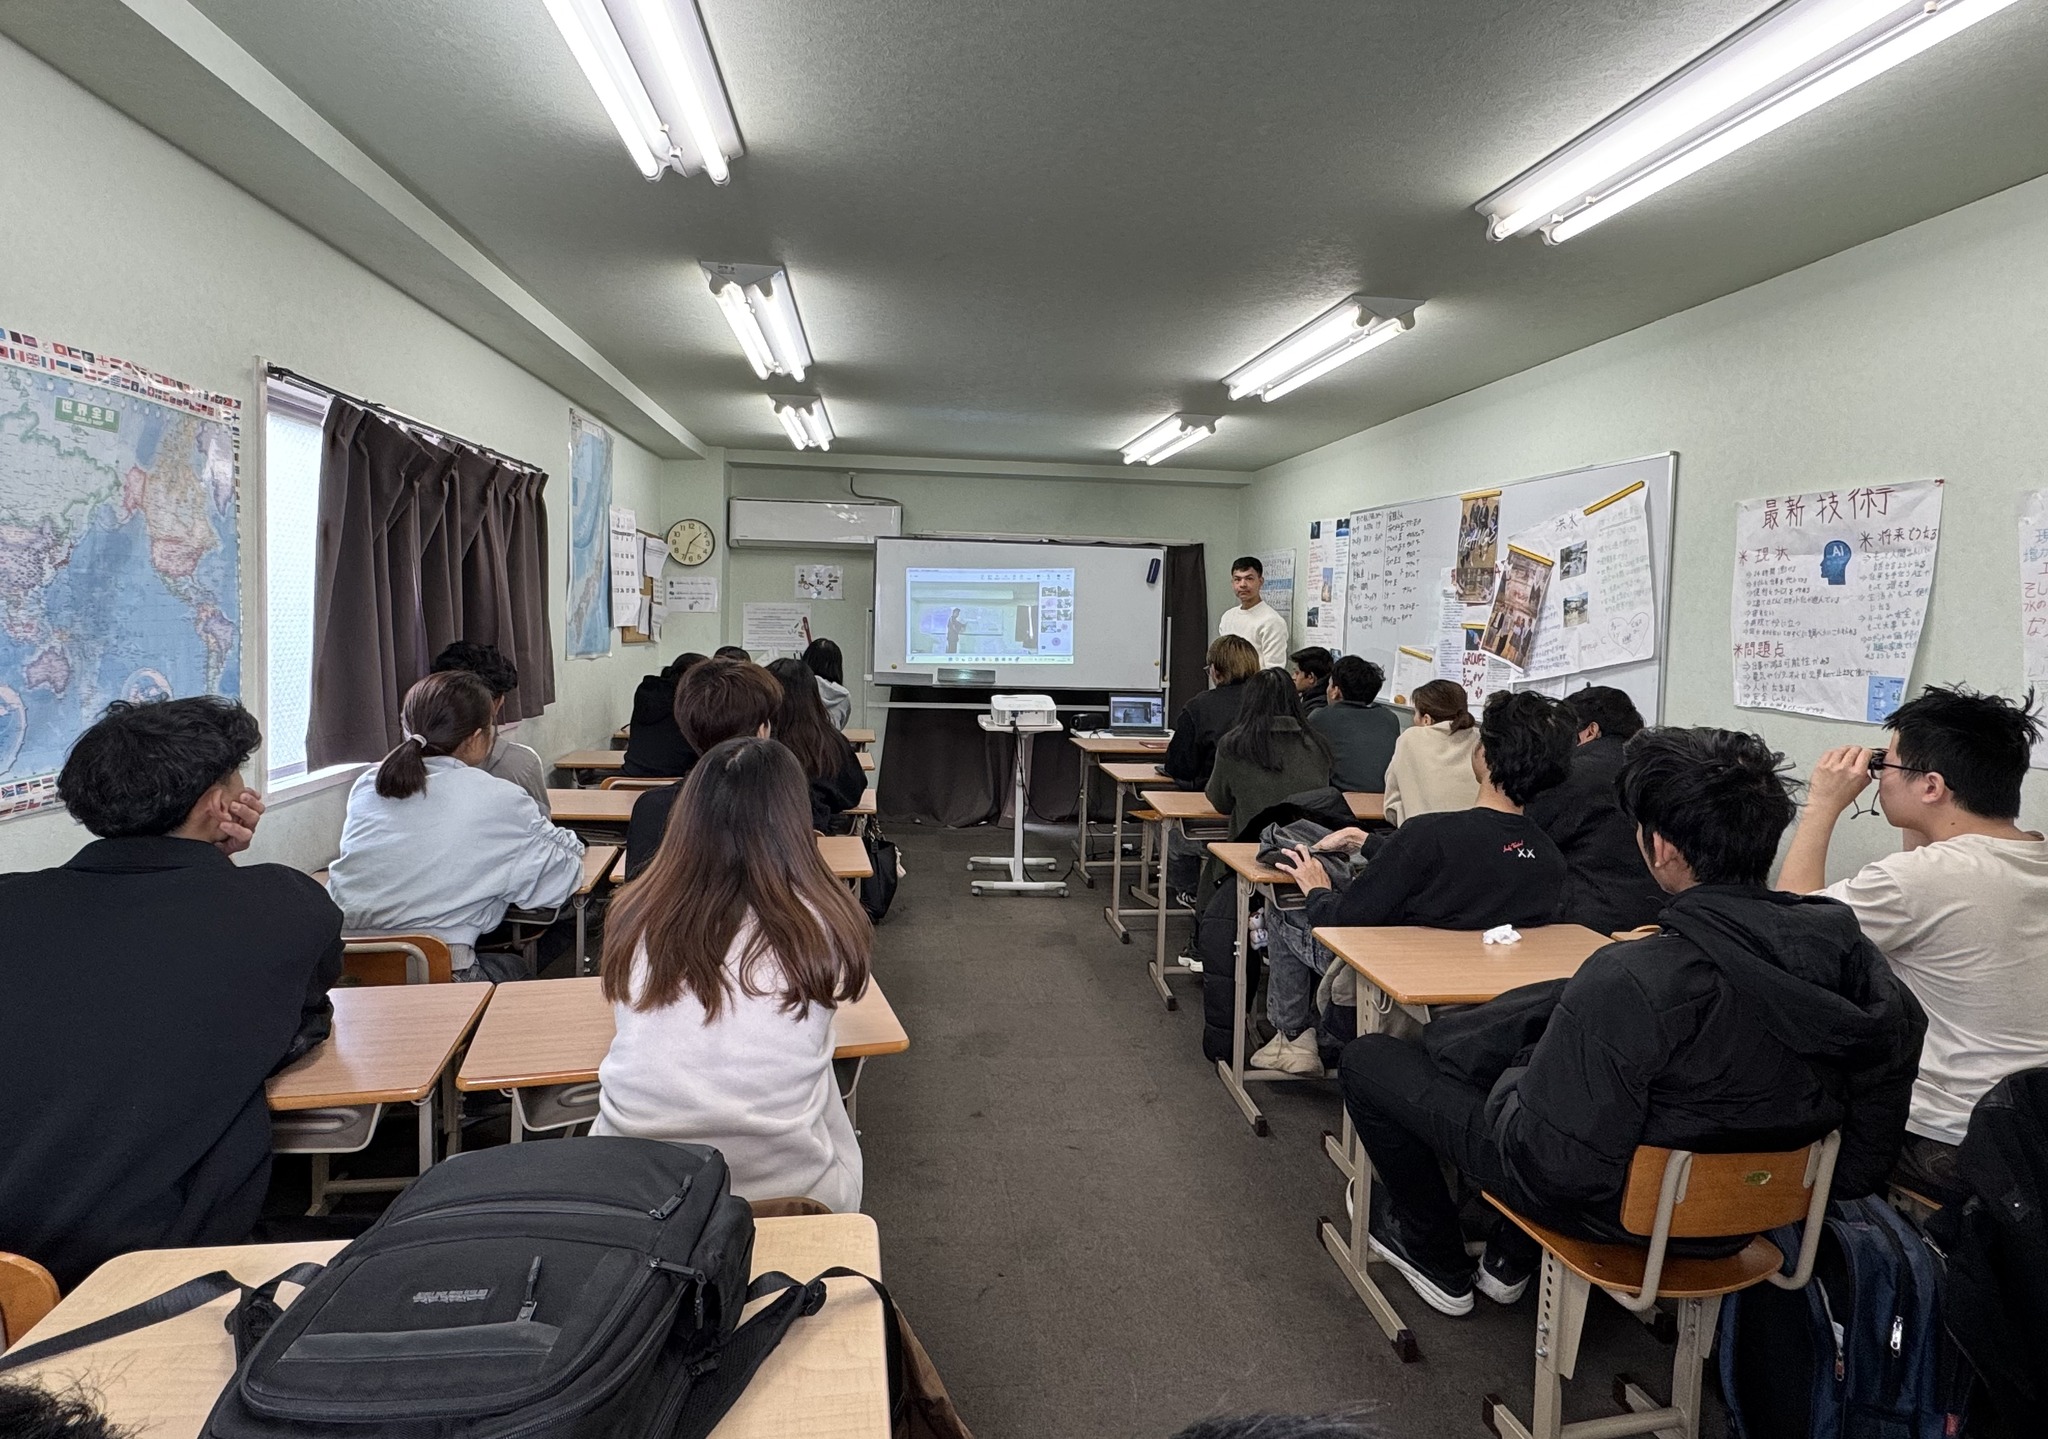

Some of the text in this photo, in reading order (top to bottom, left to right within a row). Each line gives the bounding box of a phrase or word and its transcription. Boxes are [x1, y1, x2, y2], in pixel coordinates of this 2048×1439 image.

[1762, 487, 1895, 529] 最新技術
[1755, 547, 1791, 563] 現状
[1832, 545, 1844, 557] AI
[1744, 641, 1785, 658] 問題点
